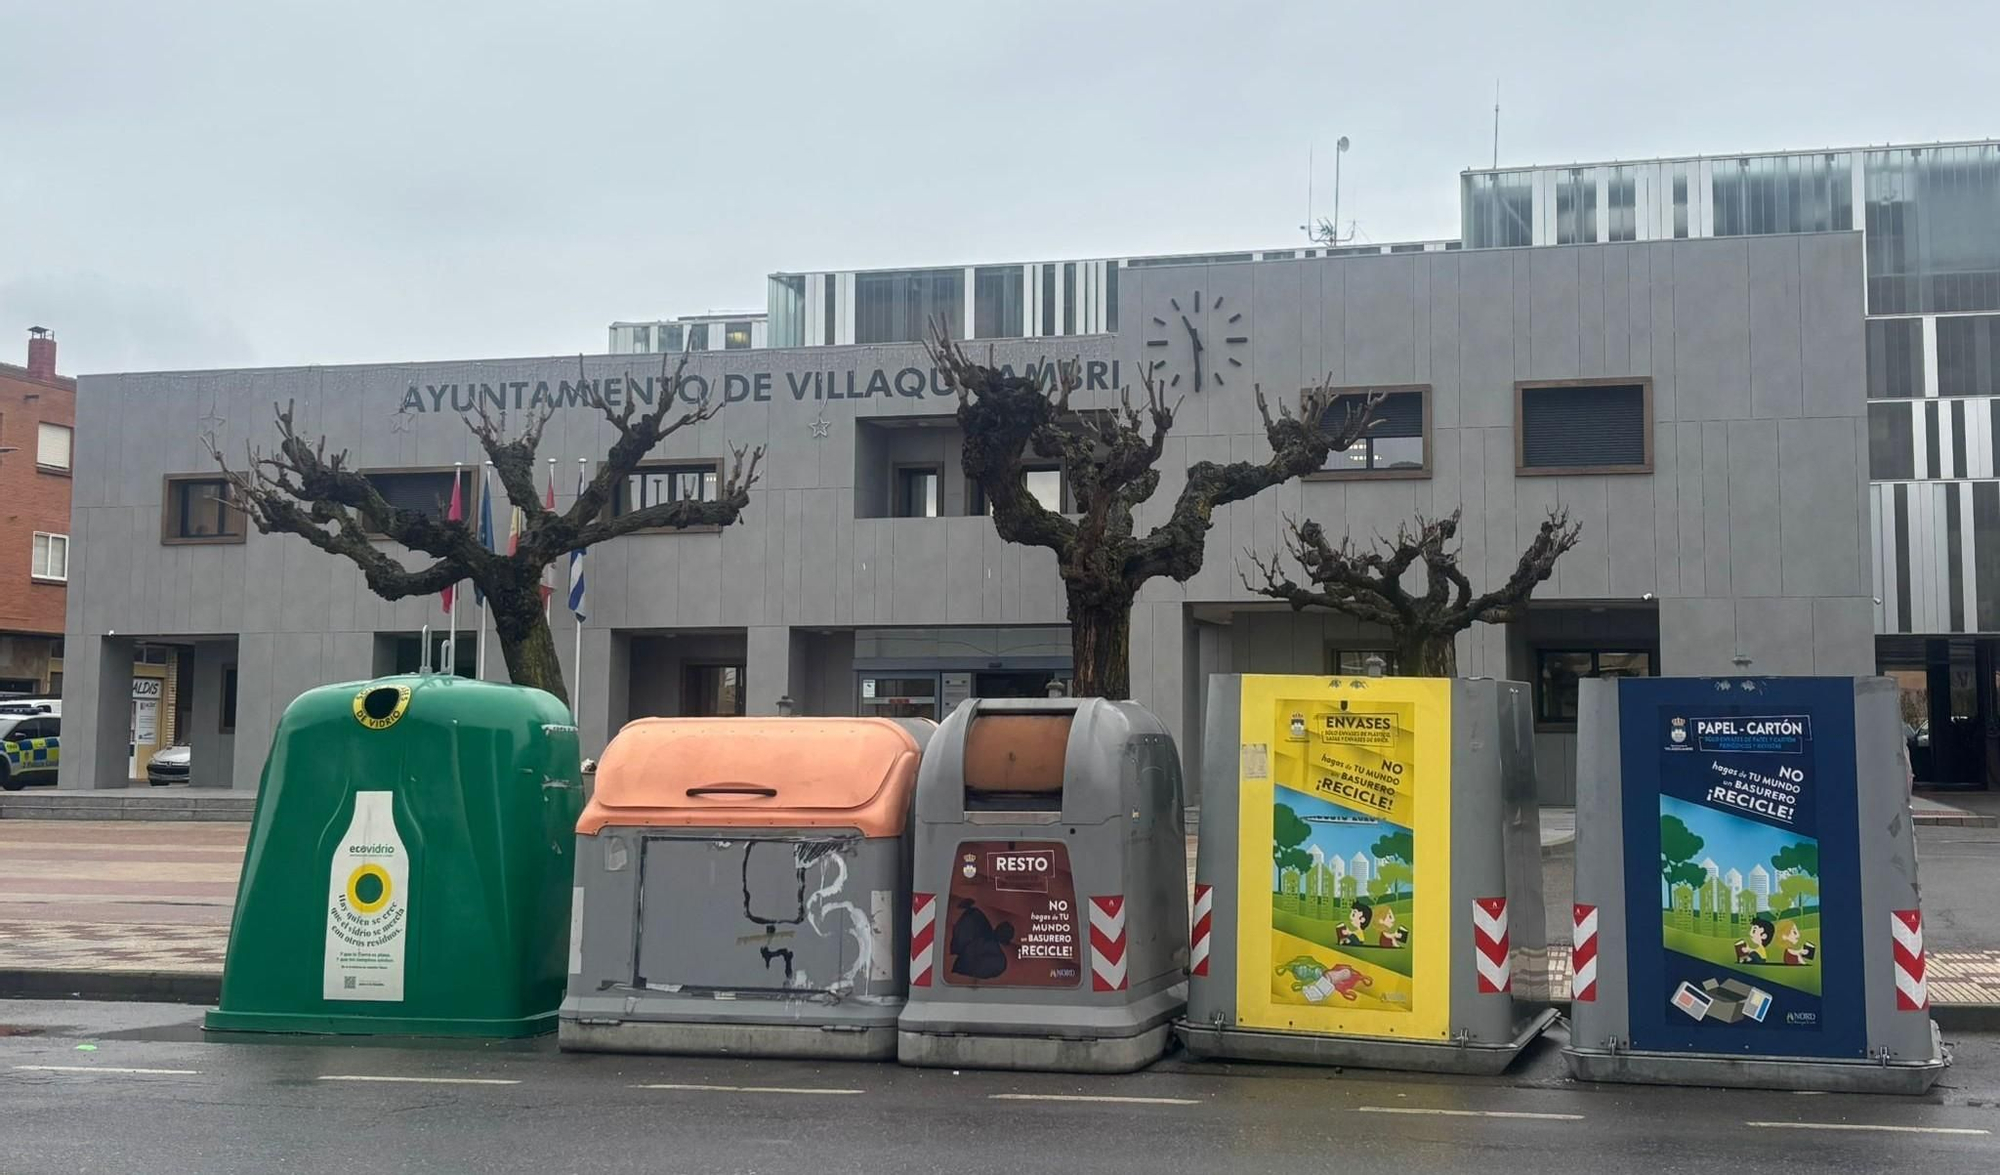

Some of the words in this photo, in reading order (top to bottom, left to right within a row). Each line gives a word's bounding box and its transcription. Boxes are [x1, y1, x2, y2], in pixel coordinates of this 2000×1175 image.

[725, 373, 772, 402] DE
[357, 710, 367, 722] DE
[369, 710, 401, 727] VIDRIO
[1326, 717, 1391, 730] ENVASES
[1698, 722, 1737, 735] PAPEL
[1747, 719, 1803, 735] CARTÓN
[1321, 754, 1344, 768] hagas
[1354, 764, 1365, 774] TU
[1366, 770, 1400, 786] MUNDO
[1381, 759, 1403, 775] NO
[1779, 765, 1804, 782] NO
[1712, 761, 1738, 776] hagas
[1738, 770, 1747, 778] de
[1749, 772, 1761, 783] TU
[1762, 776, 1801, 794] MUNDO
[1316, 777, 1393, 810] ¡RECICLE!
[1706, 786, 1795, 820] ¡RECICLE!
[349, 844, 395, 853] ecovidrio
[996, 857, 1048, 871] RESTO
[338, 894, 348, 912] Hay
[346, 912, 370, 926] quien
[371, 917, 381, 925] se
[383, 901, 398, 920] cree
[1049, 900, 1068, 911] NO
[331, 907, 342, 922] que
[340, 920, 349, 929] el
[349, 925, 372, 938] vidrio
[372, 928, 382, 936] se
[382, 908, 405, 932] mezcla
[1031, 912, 1051, 922] hagas
[331, 925, 345, 939] con
[344, 935, 365, 947] otros
[1032, 924, 1070, 932] MUNDO
[1018, 945, 1073, 959] ¡RECICLE!
